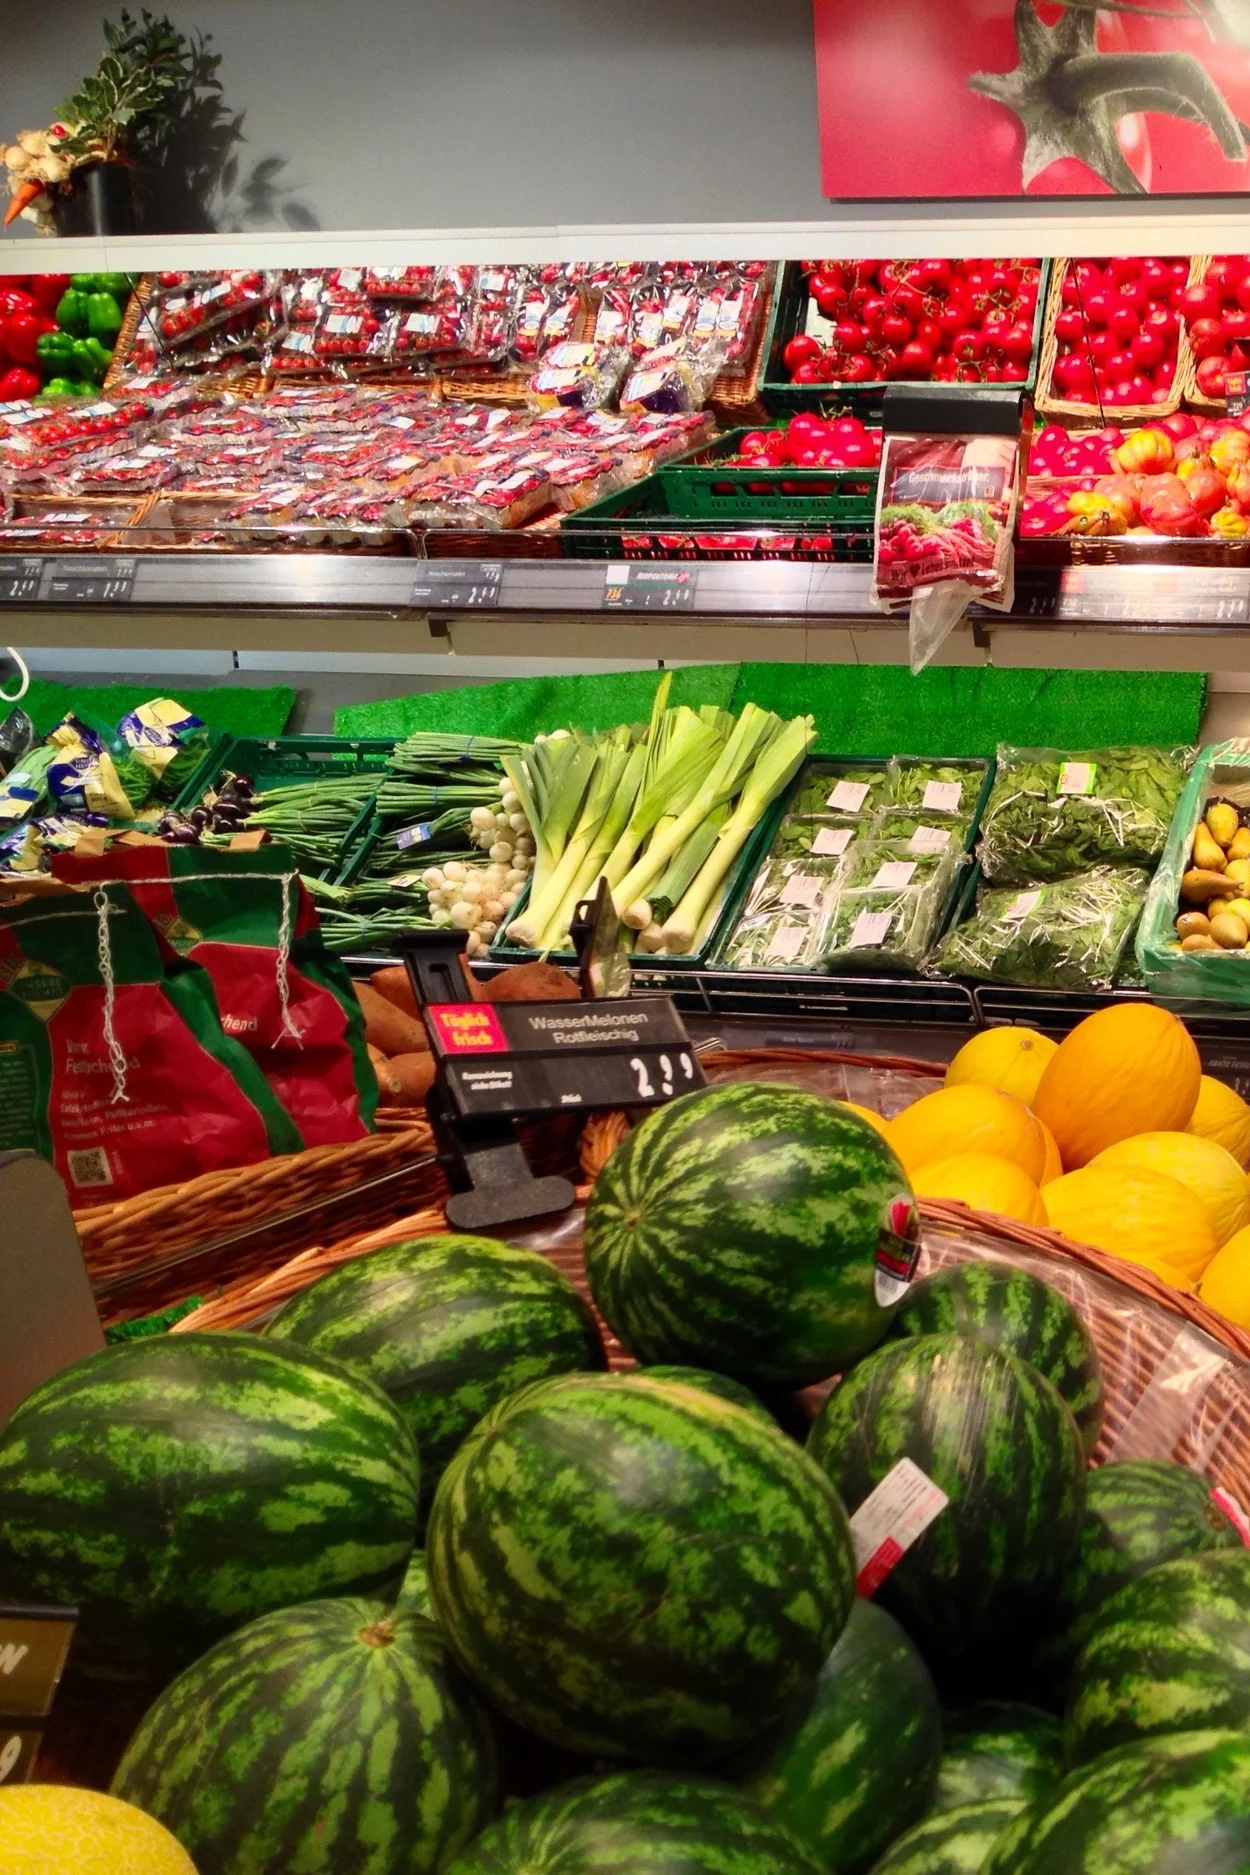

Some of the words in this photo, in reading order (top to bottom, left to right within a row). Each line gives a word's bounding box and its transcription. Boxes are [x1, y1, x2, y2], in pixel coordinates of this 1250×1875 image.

[440, 1012, 490, 1031] Täglich
[528, 1011, 649, 1031] WasserMelonen
[452, 1030, 493, 1046] frisch
[552, 1027, 640, 1045] Rotfleischig
